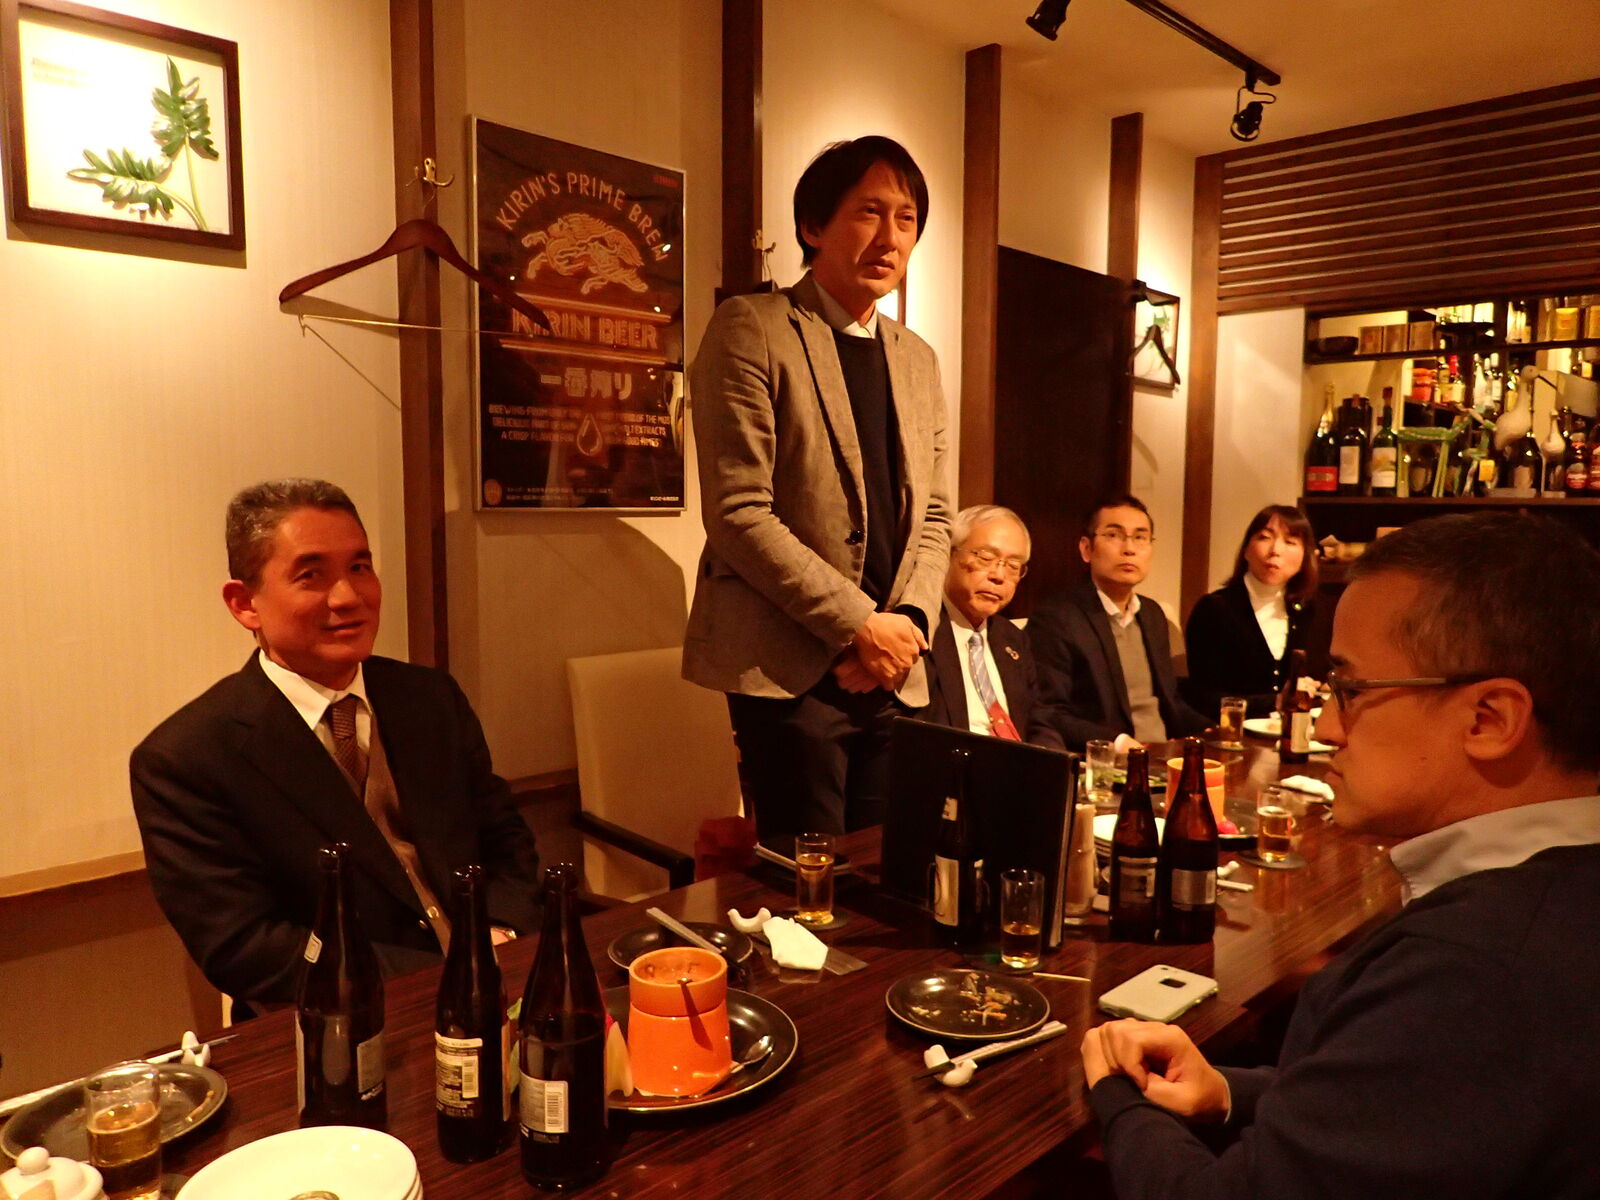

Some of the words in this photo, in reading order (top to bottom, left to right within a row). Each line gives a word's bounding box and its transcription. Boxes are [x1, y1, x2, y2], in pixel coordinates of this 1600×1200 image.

[496, 172, 561, 230] KIRIN'S
[567, 171, 626, 211] PRIME
[628, 203, 671, 262] BREW
[600, 317, 658, 349] BEER
